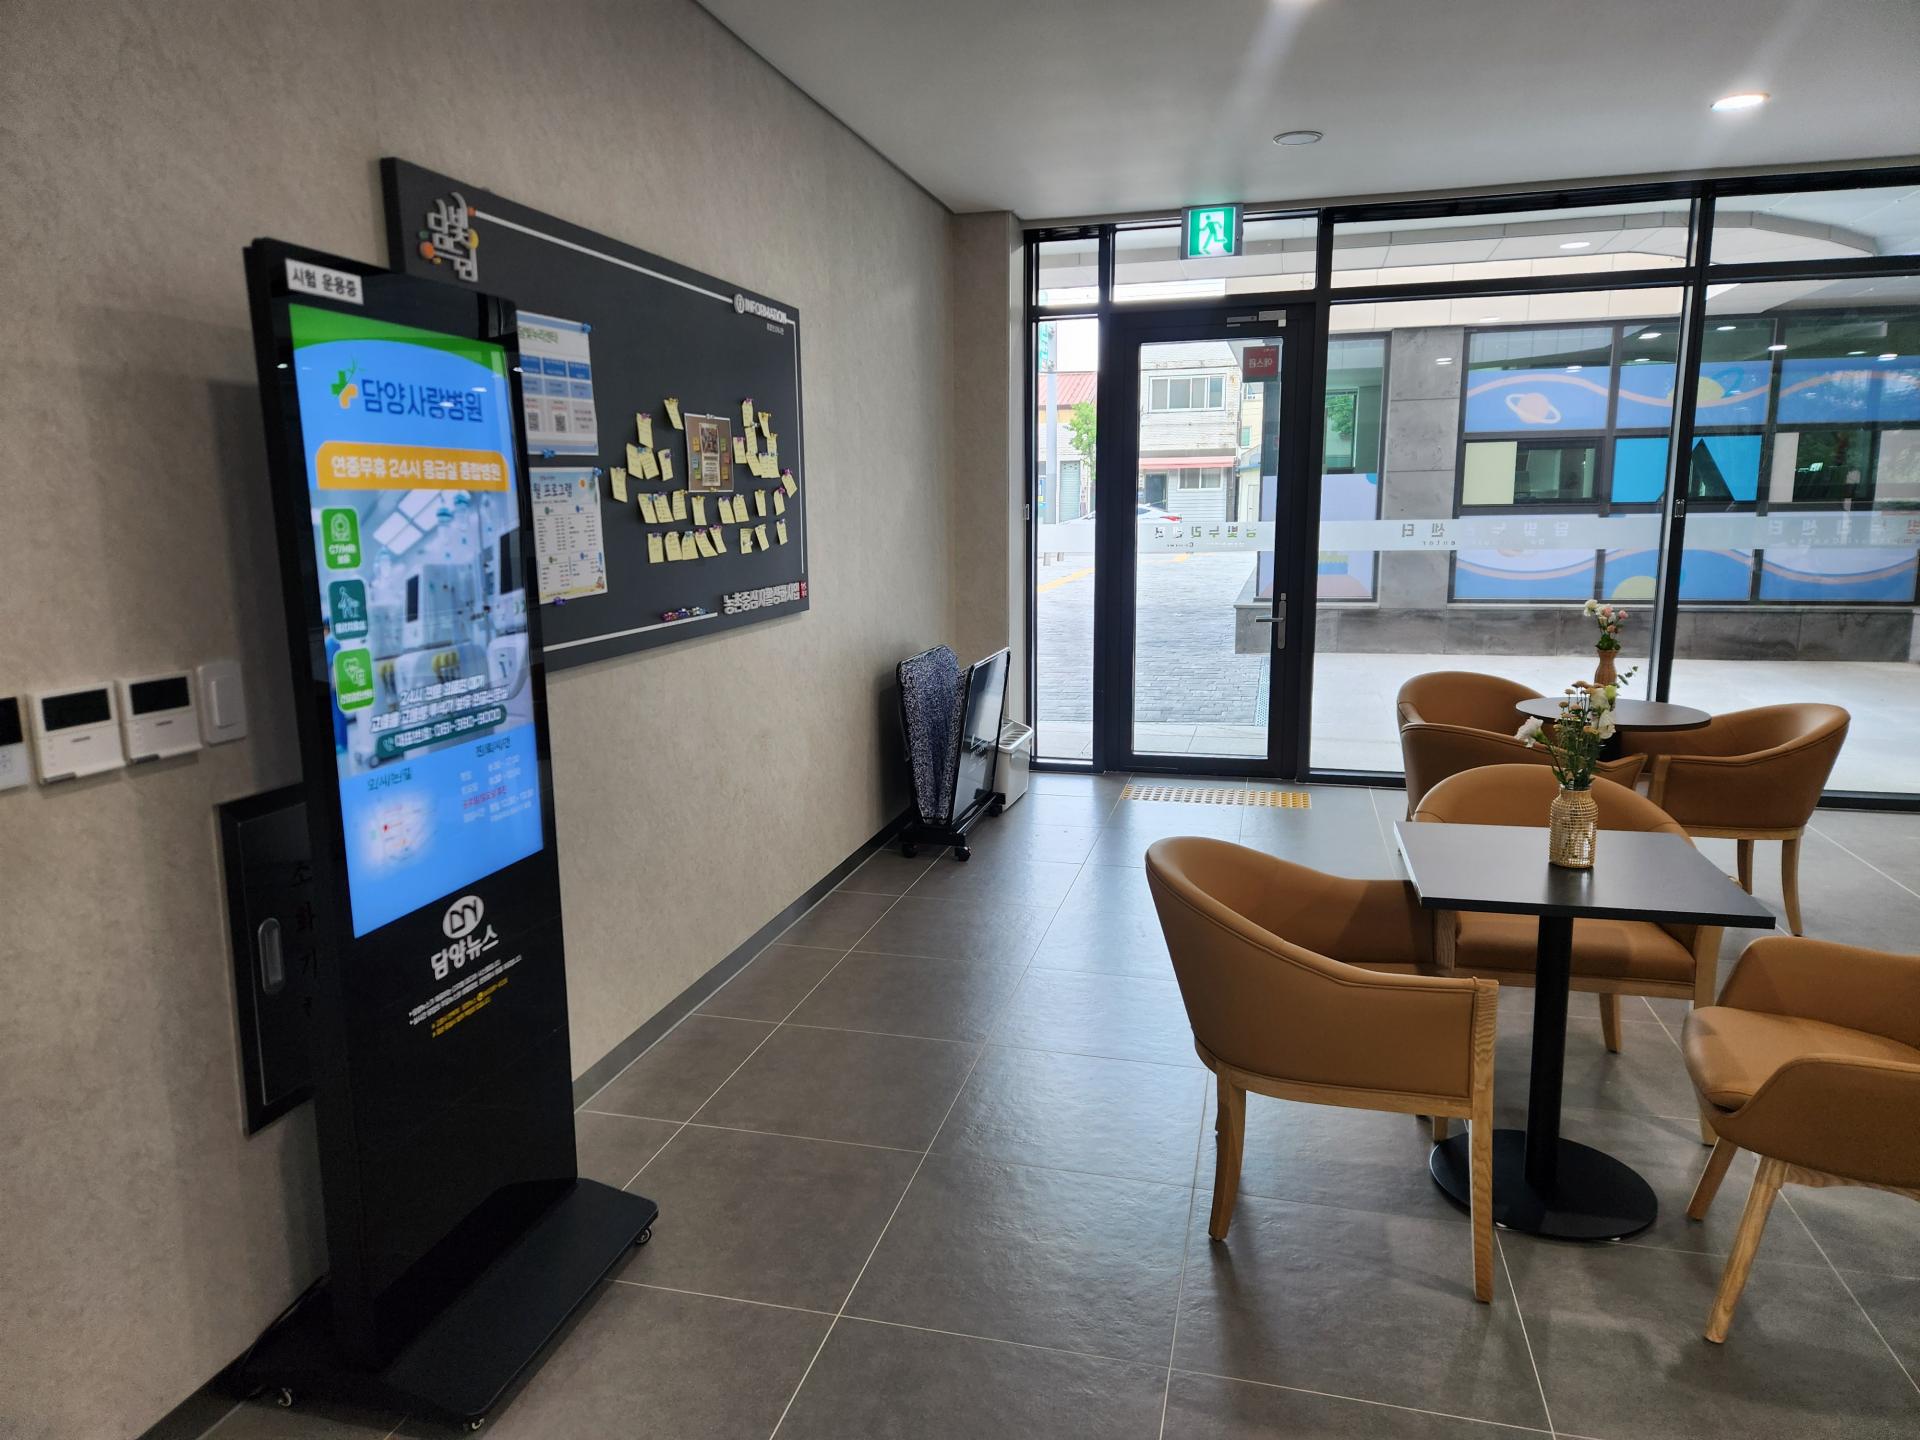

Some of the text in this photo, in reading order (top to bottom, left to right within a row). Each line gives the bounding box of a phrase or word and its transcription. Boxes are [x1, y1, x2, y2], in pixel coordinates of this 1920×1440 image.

[293, 267, 316, 288] 시험
[362, 379, 483, 423] 담양사랑병원
[332, 455, 386, 478] 연중무휴
[389, 458, 421, 479] 24시
[431, 924, 500, 980] 담양뉴스
